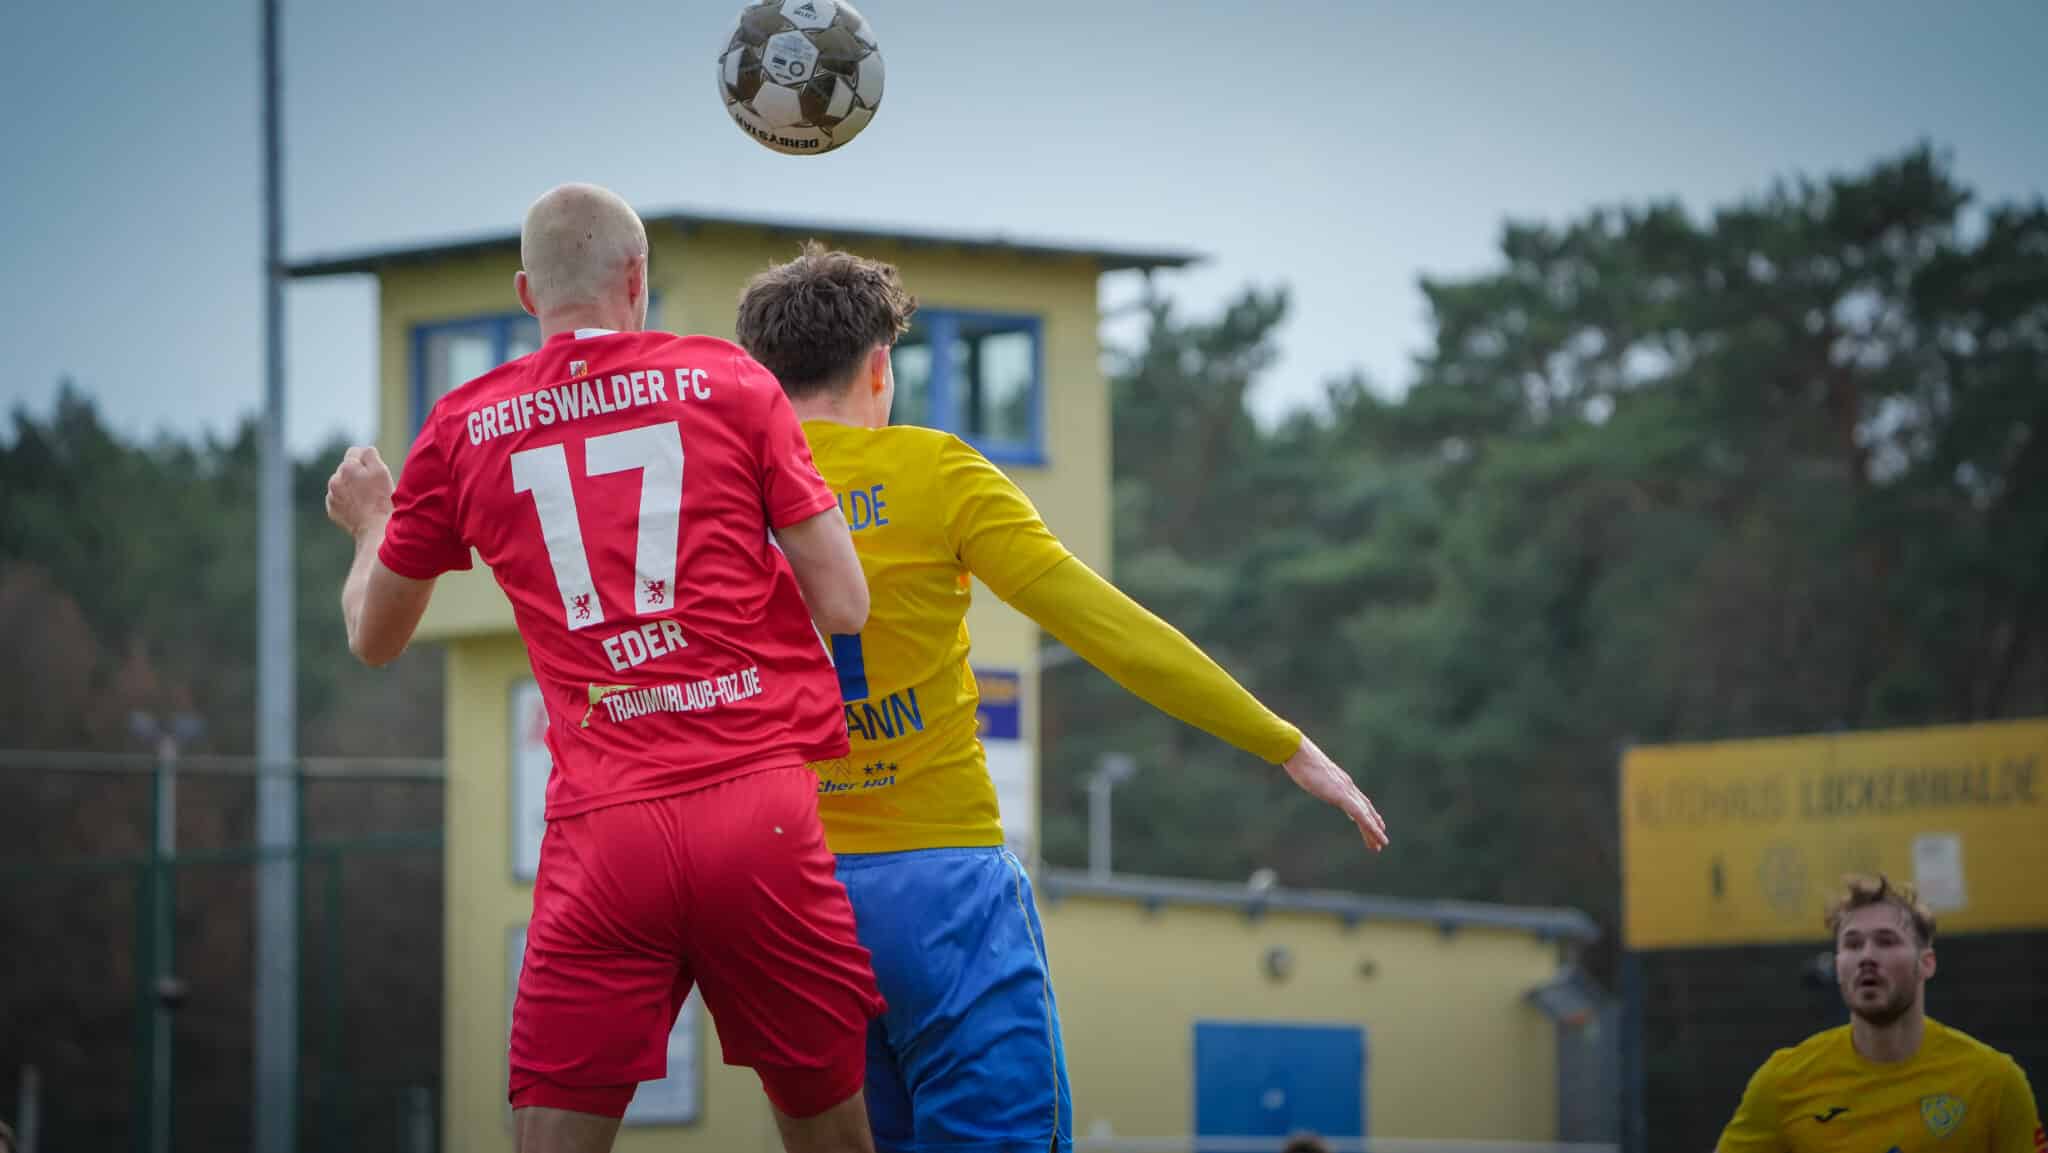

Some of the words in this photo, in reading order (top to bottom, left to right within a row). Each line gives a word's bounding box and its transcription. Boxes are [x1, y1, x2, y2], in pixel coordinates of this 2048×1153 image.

[467, 369, 669, 446] GREIFSWALDER
[675, 368, 712, 401] FC
[510, 420, 685, 631] 17
[601, 620, 689, 672] EDER
[602, 666, 763, 724] TRAUMURLAUB-FDZ.DE
